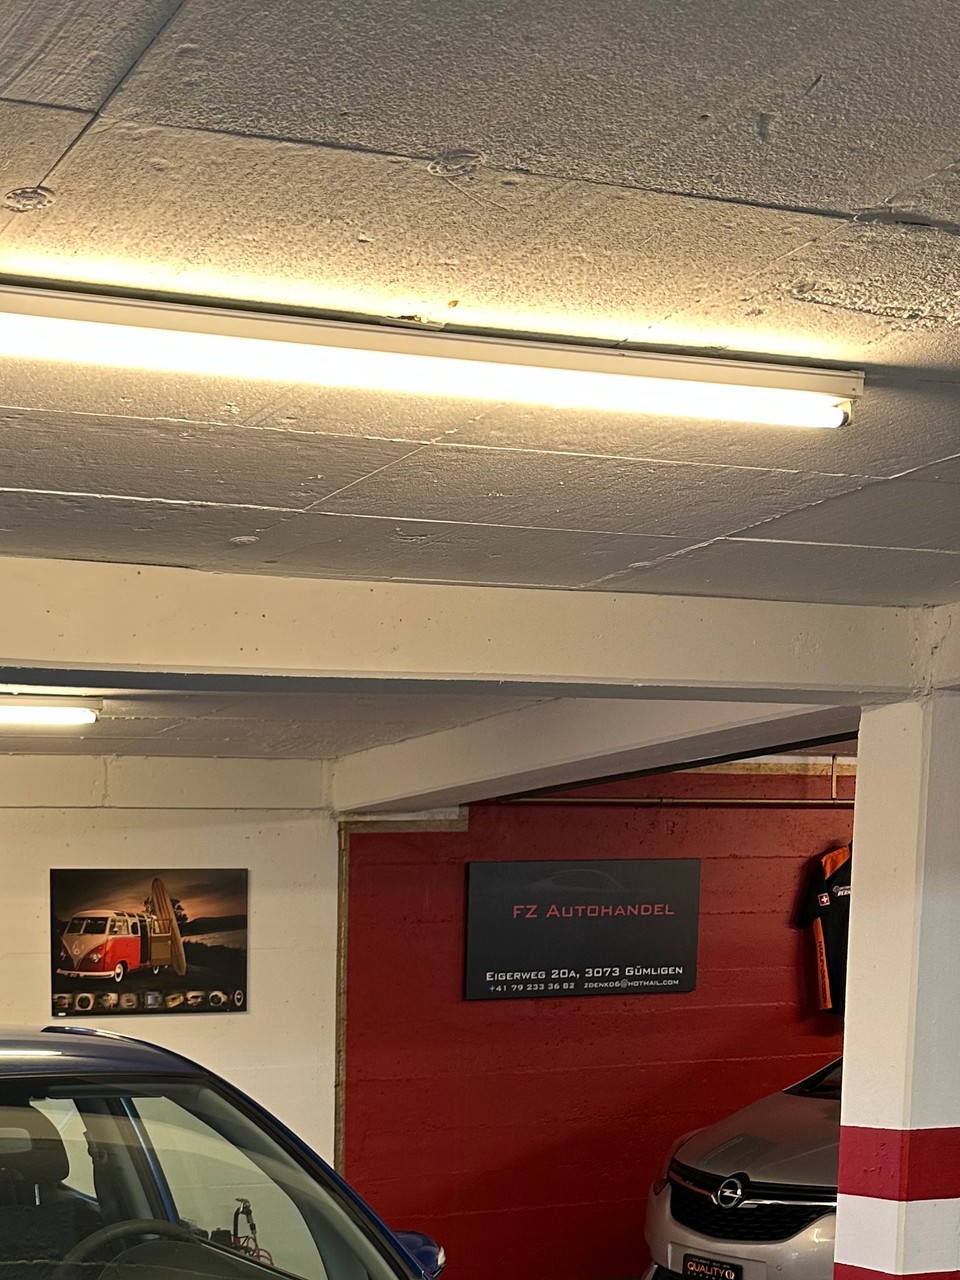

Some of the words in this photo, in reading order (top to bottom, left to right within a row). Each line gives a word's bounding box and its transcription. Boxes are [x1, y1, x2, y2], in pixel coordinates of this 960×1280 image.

[512, 904, 538, 919] FZ
[545, 903, 675, 918] AUTOHANDEL
[486, 969, 546, 981] EIGERWEG
[585, 967, 620, 978] 3073
[625, 964, 683, 976] GÜMLIGEN
[489, 984, 507, 992] +41
[511, 984, 524, 992] 79
[526, 983, 545, 991] 233
[547, 982, 560, 990] 36
[687, 1261, 726, 1278] QUALITY
